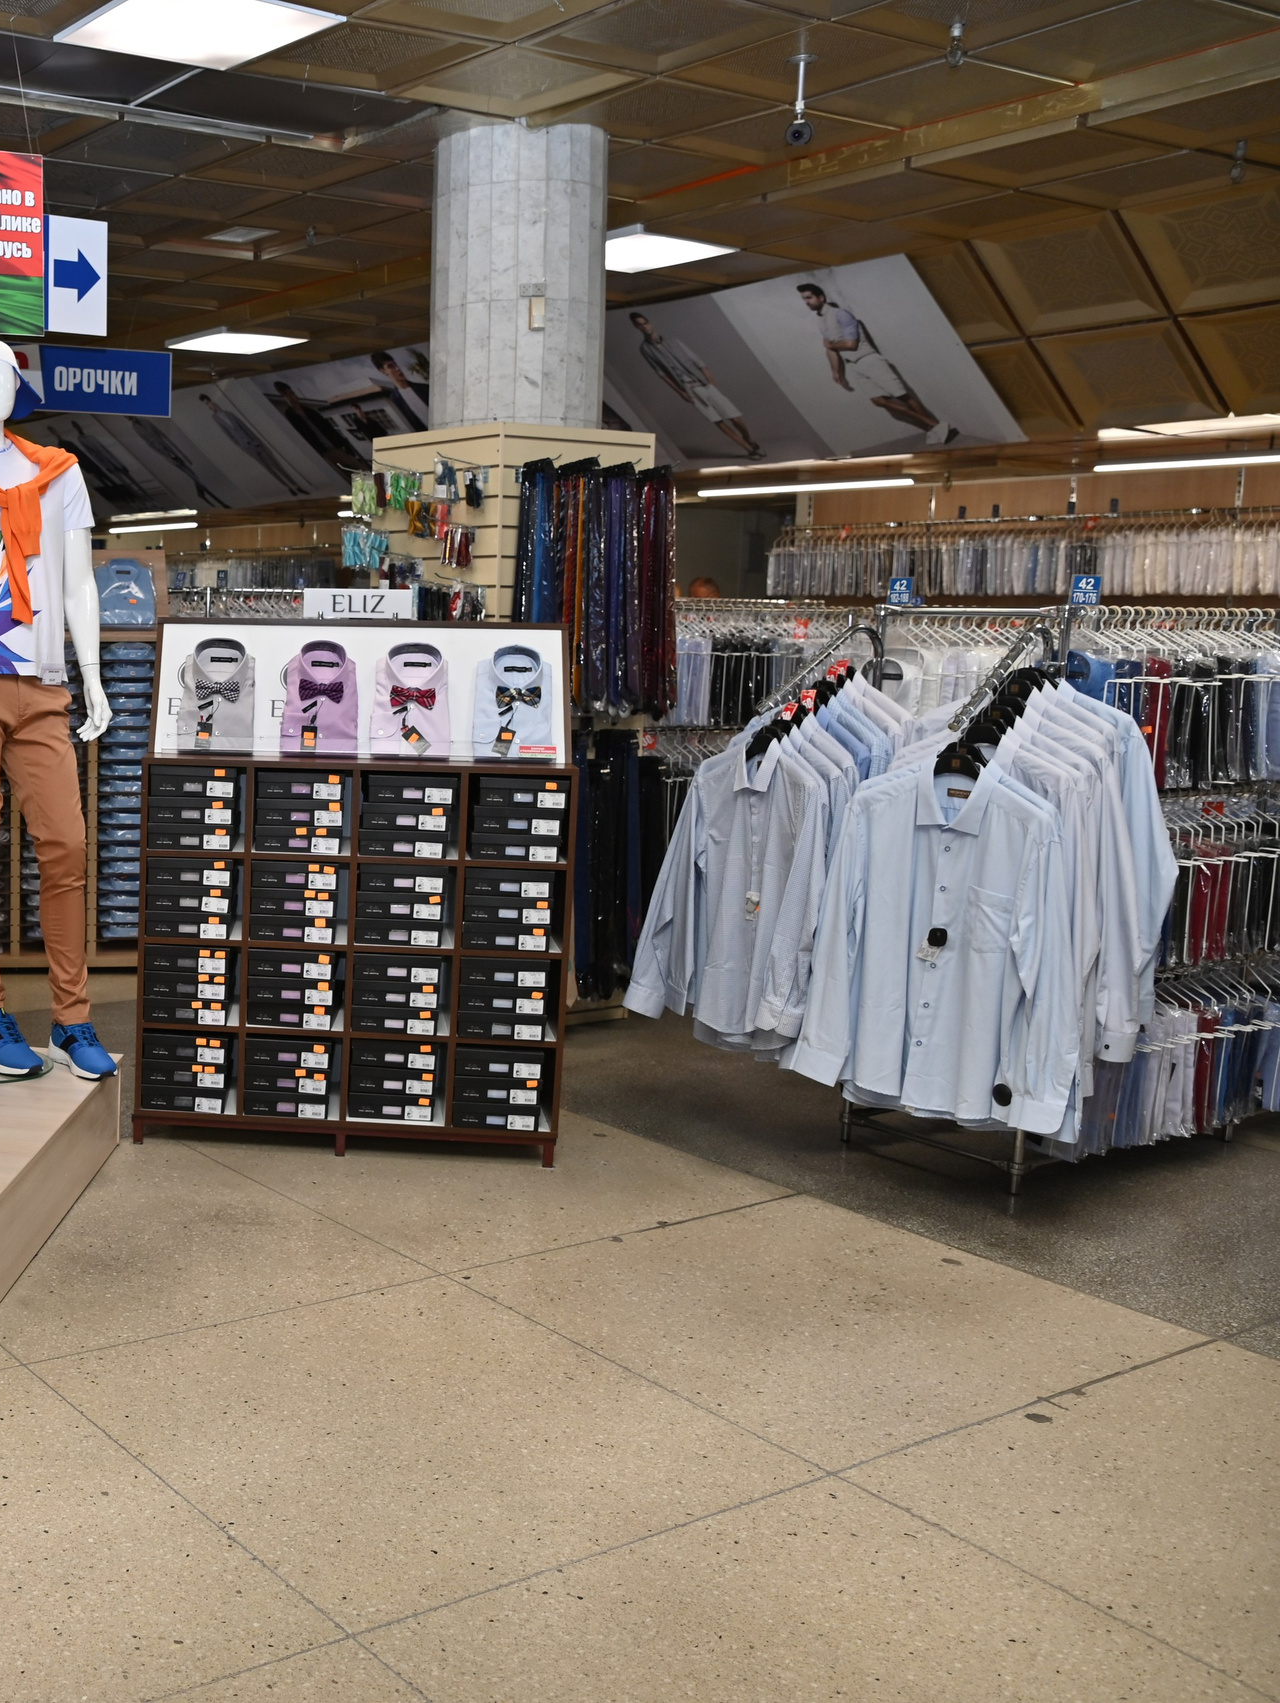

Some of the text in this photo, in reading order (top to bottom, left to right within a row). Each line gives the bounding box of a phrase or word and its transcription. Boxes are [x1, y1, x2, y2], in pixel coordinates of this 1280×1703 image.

[24, 191, 35, 206] в
[893, 579, 908, 591] 42
[1078, 577, 1095, 590] 42
[331, 594, 385, 613] ELIZ
[1073, 592, 1097, 604] 170-176
